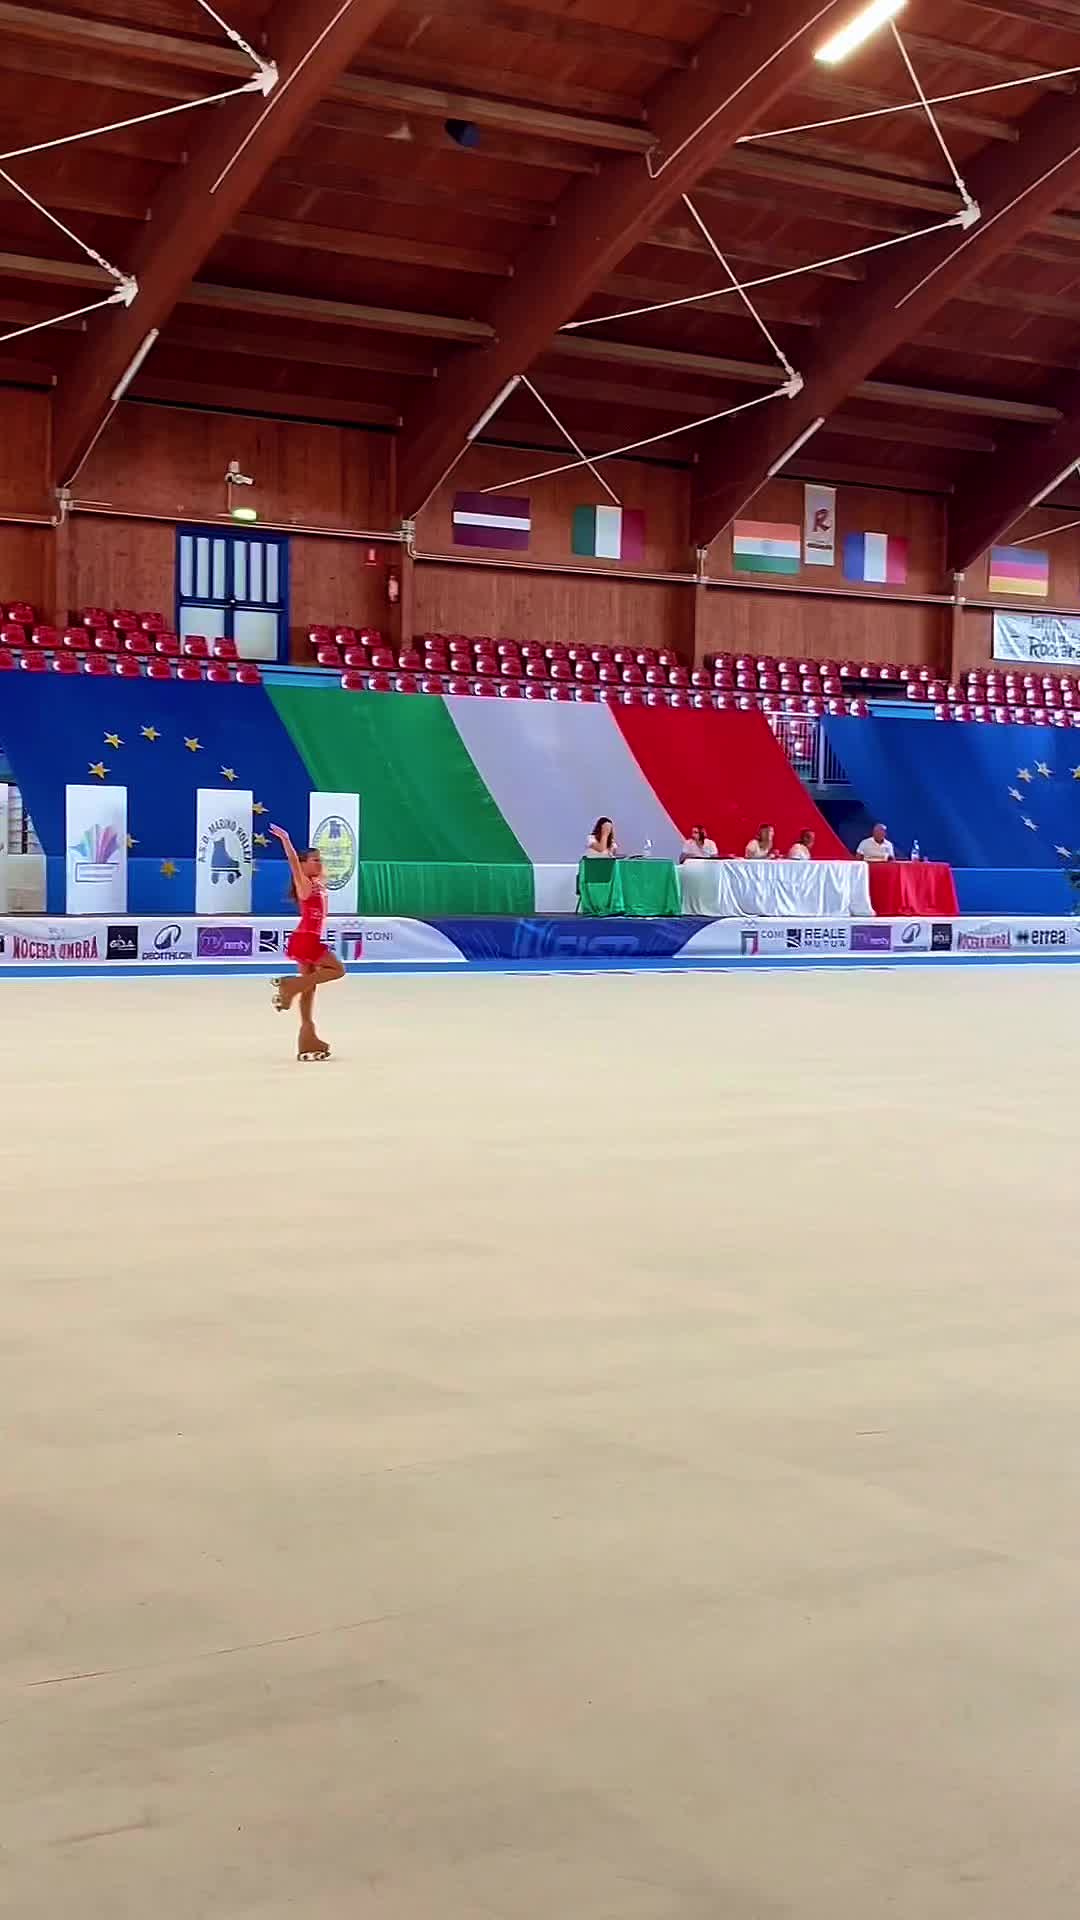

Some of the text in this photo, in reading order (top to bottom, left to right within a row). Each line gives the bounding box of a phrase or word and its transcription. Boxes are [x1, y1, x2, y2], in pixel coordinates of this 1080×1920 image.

[365, 931, 393, 941] CONI
[804, 928, 846, 939] REALE
[12, 935, 98, 959] NOCERA UMBRA
